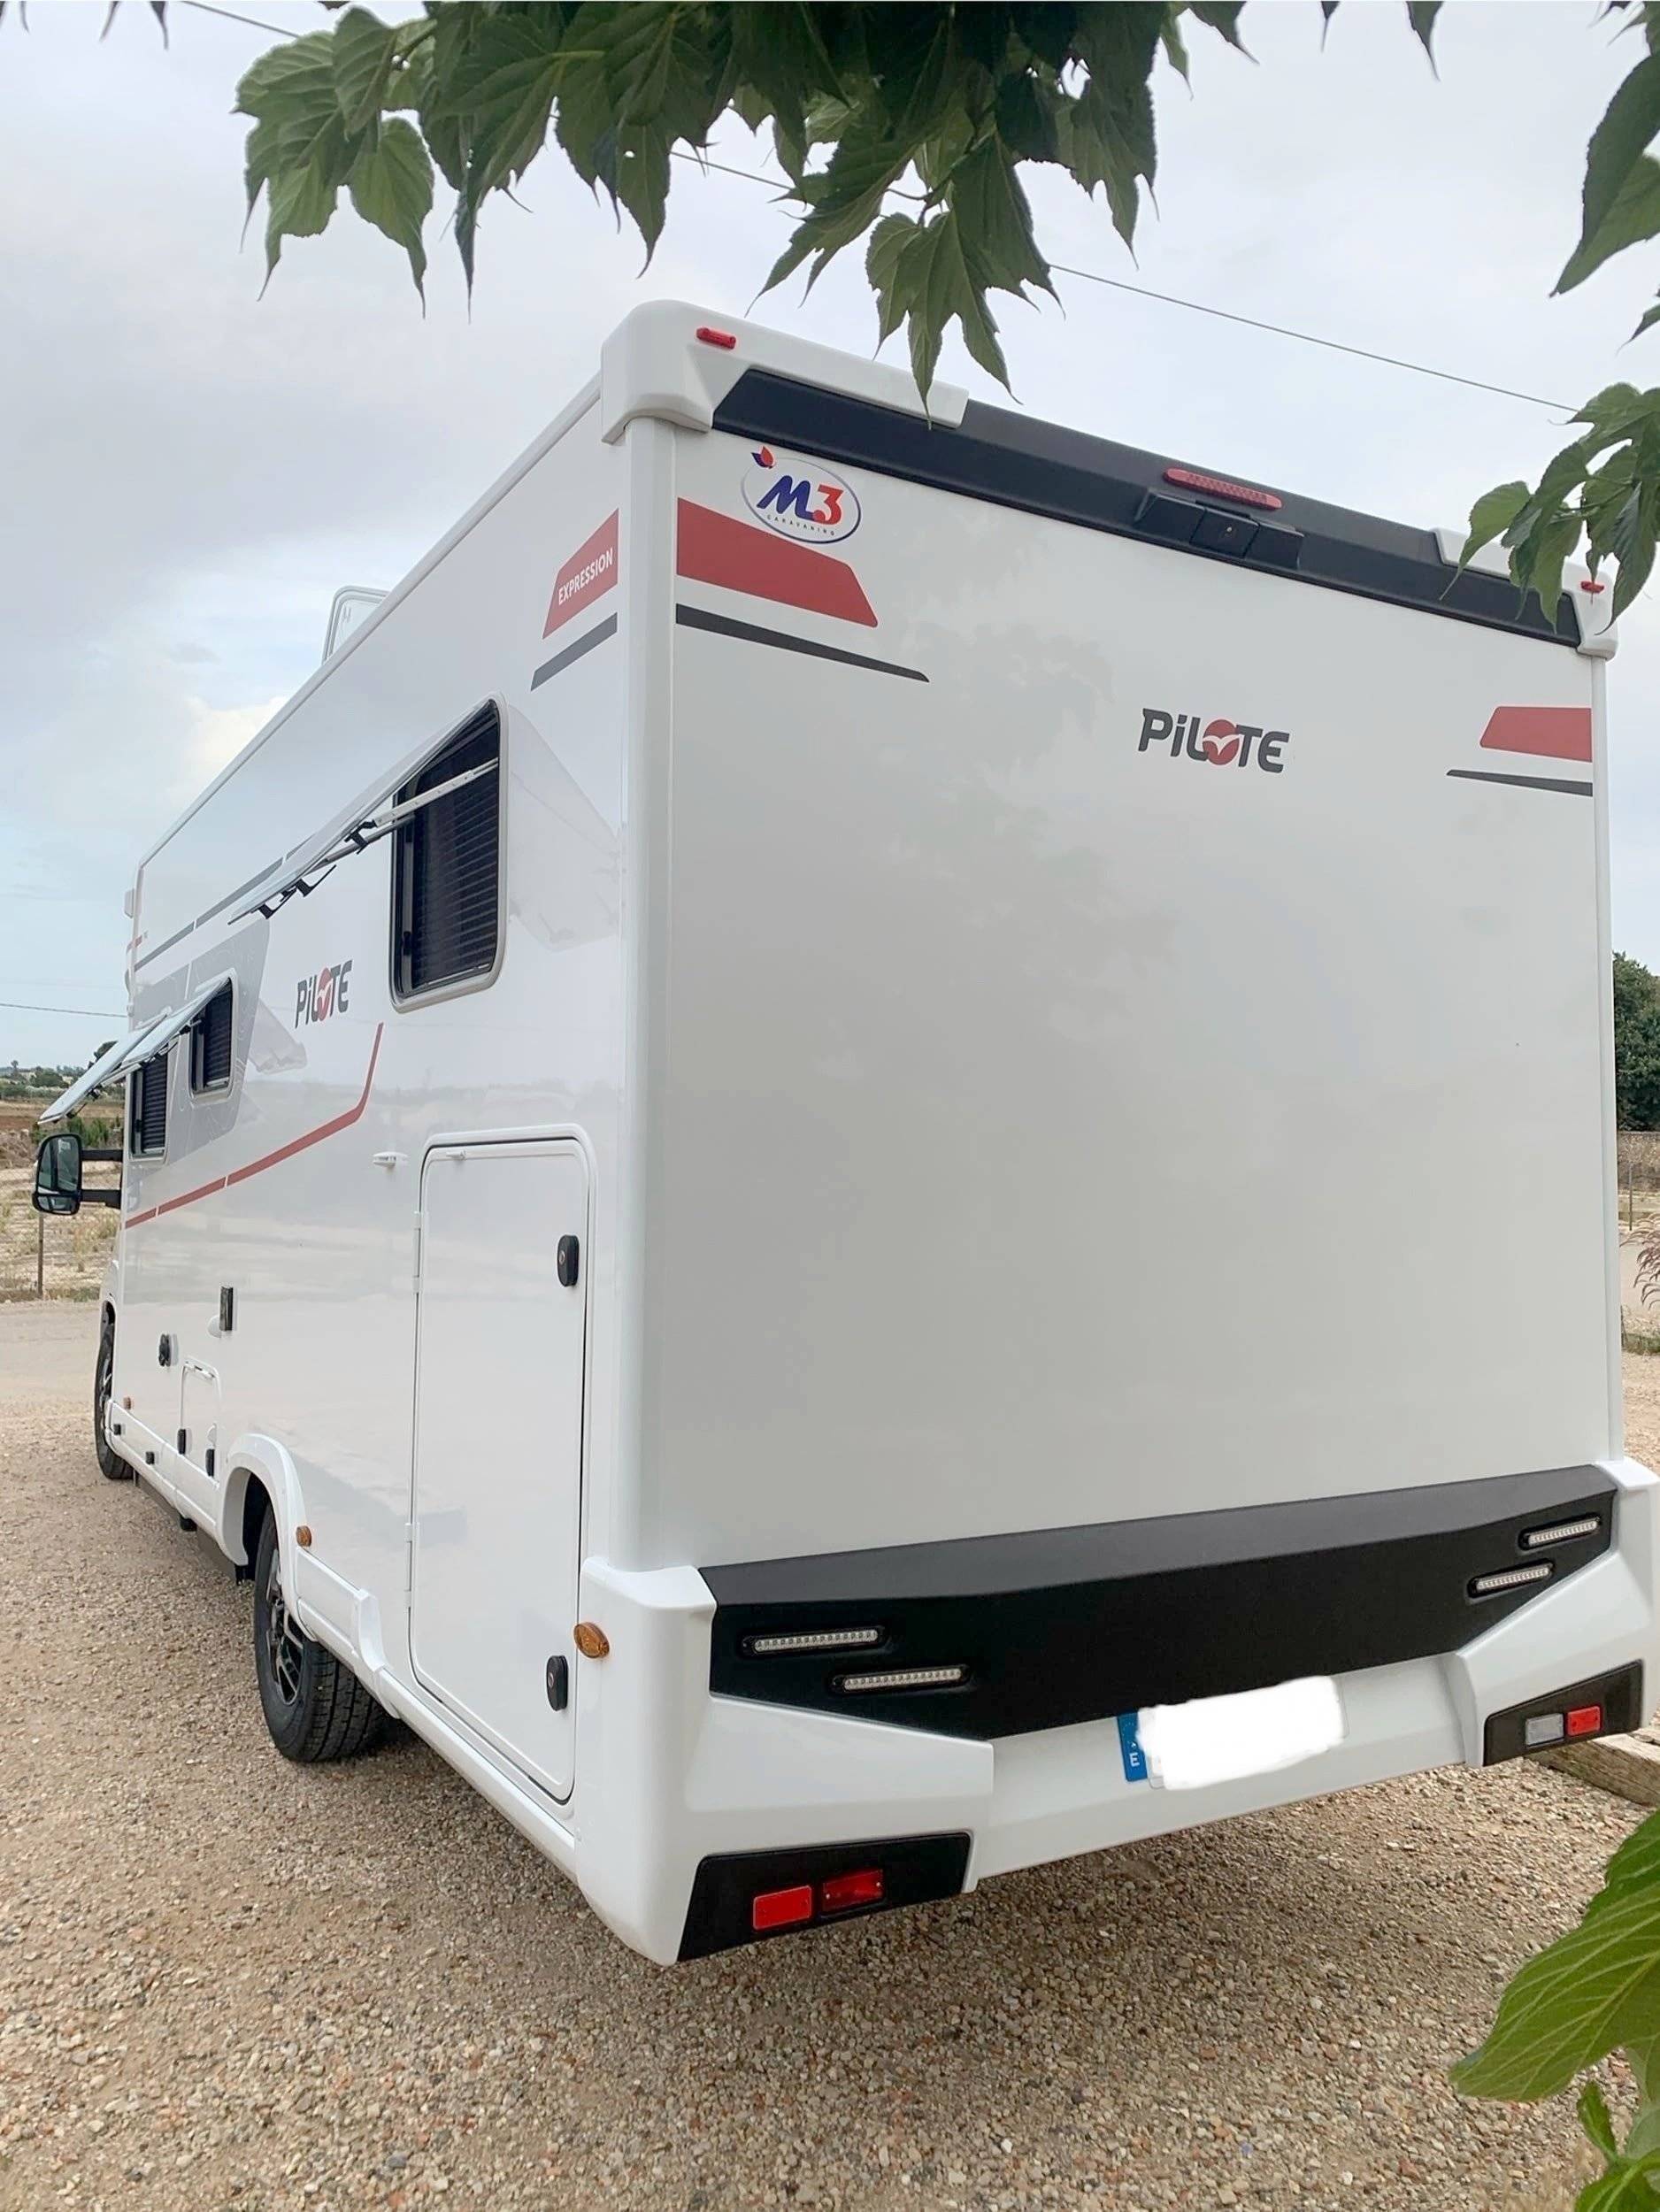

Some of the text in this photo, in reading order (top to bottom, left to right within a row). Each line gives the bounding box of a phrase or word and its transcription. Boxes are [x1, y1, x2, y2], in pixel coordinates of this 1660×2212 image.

[756, 475, 844, 525] M3
[766, 514, 836, 536] CARAVANING
[557, 548, 614, 606] EXPRESSION
[1130, 1752, 1141, 1767] E
